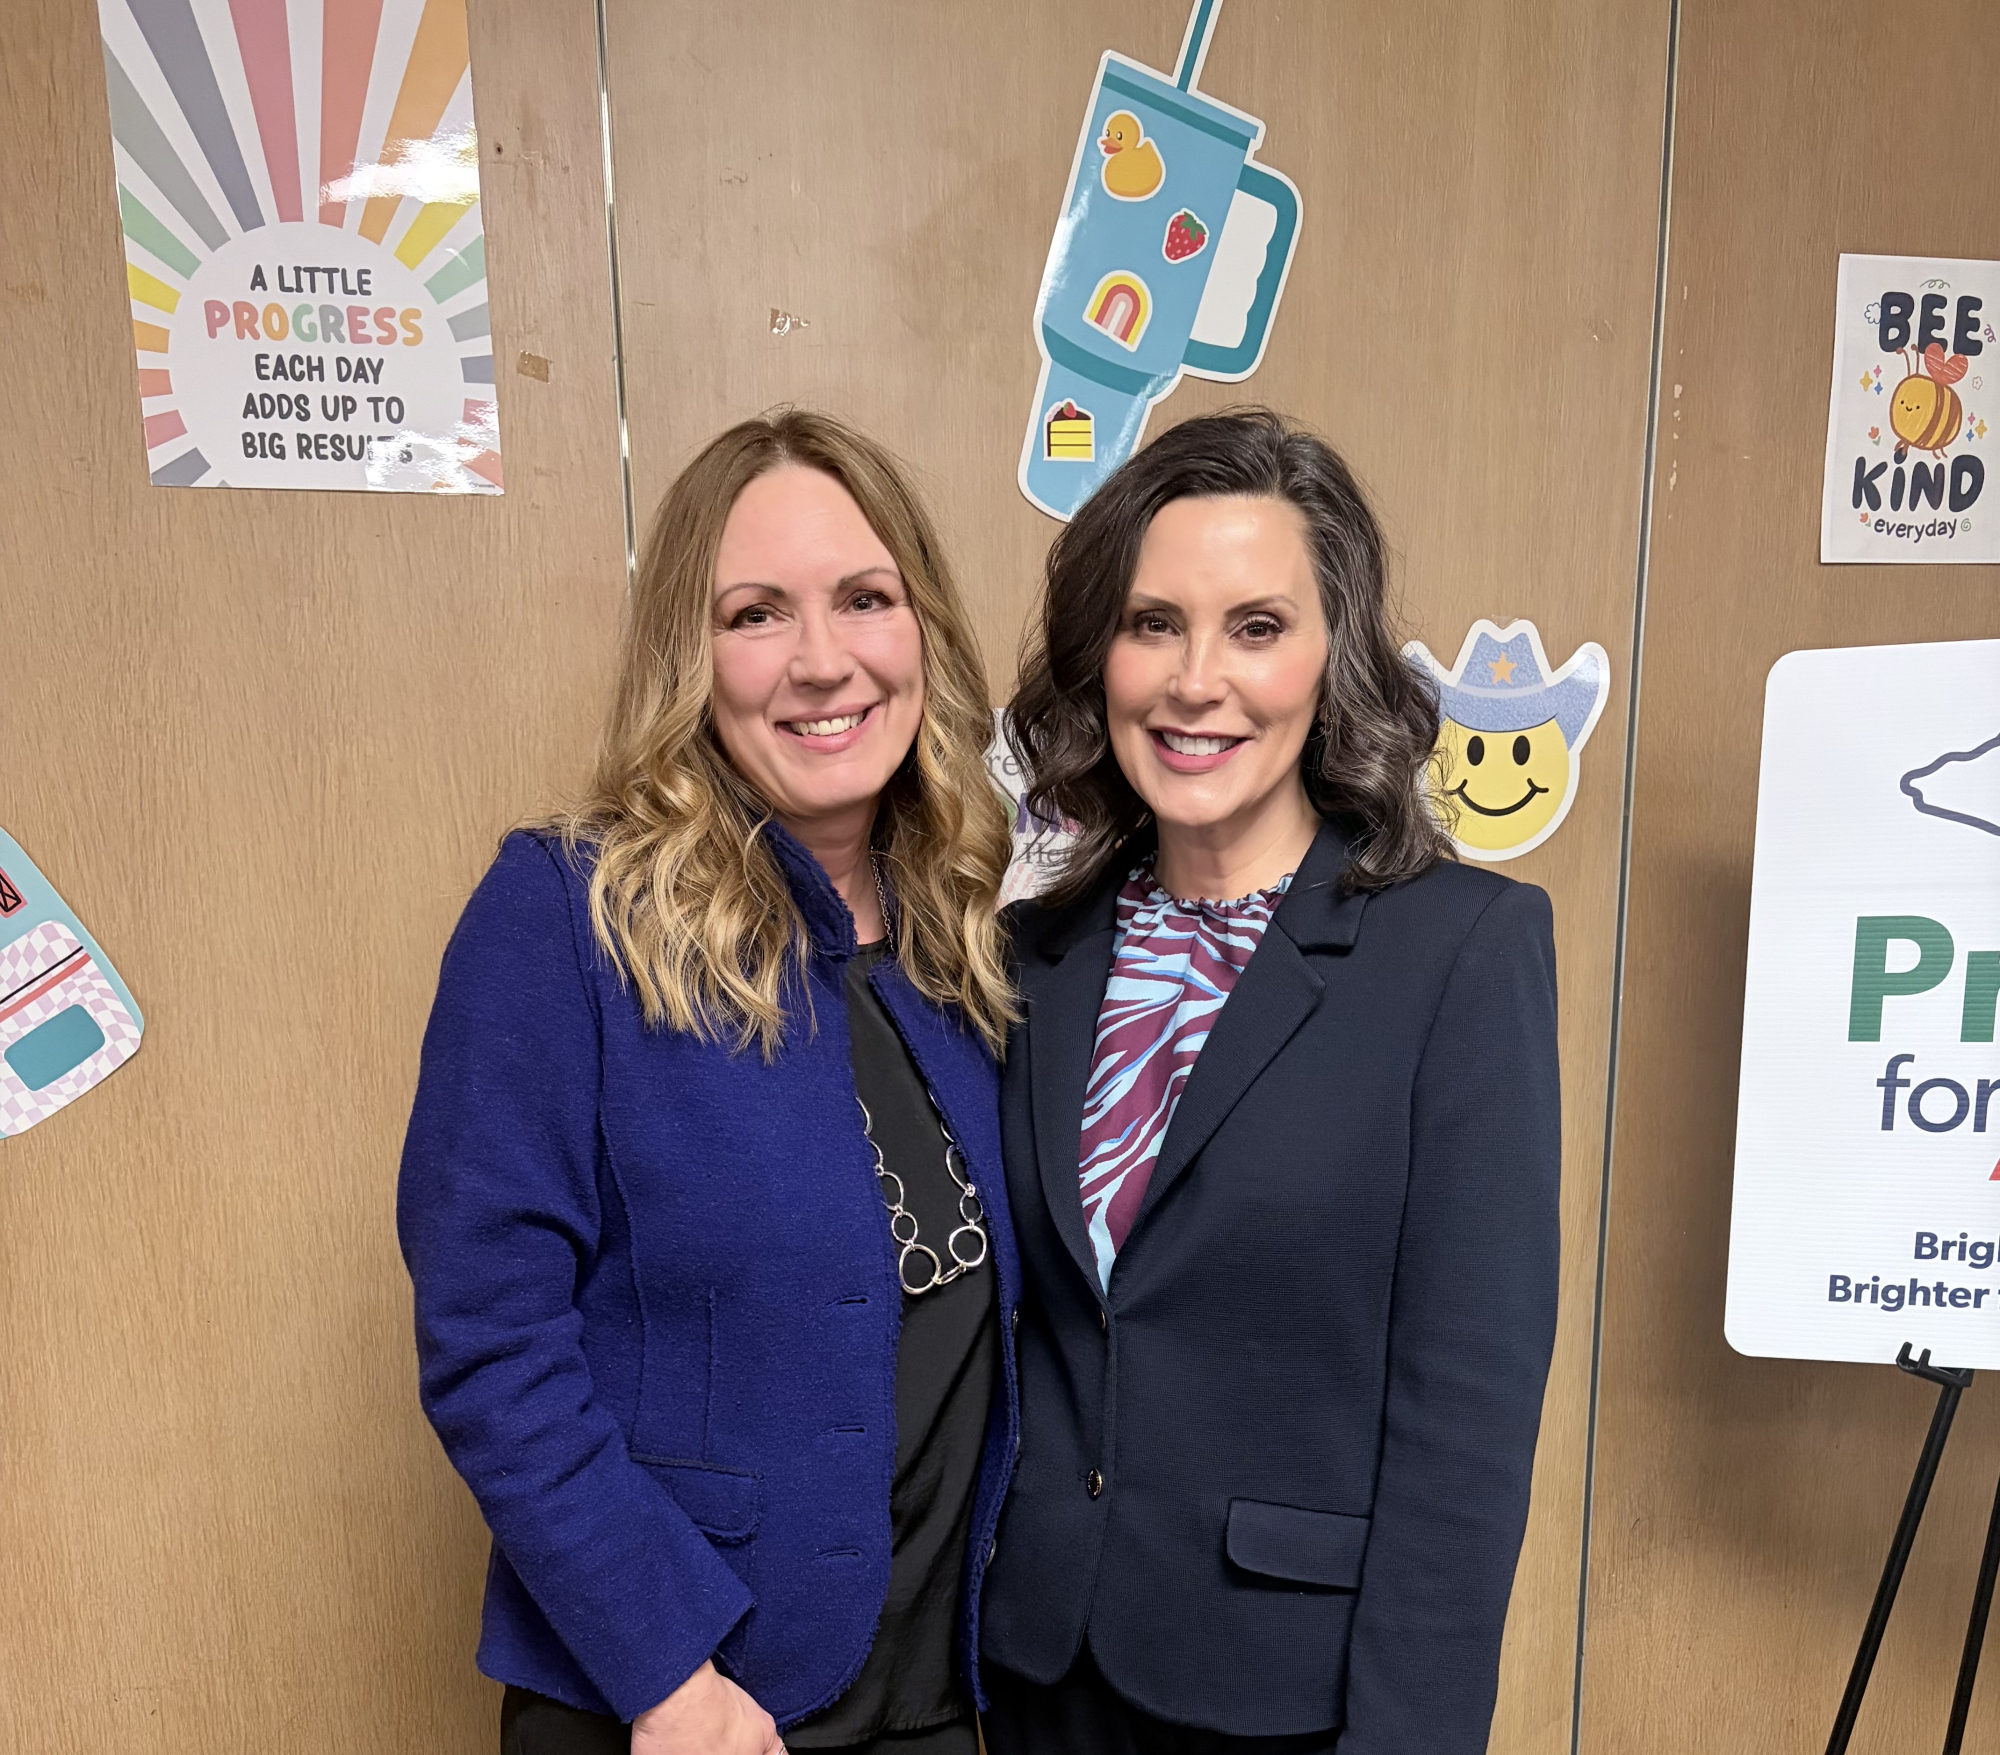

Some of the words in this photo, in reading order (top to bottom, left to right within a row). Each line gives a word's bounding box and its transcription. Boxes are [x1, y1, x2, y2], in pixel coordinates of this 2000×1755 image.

[250, 264, 268, 291] A
[277, 265, 372, 296] LITTLE
[204, 300, 424, 346] PROGRESS
[1879, 291, 1983, 356] BEE
[255, 353, 325, 382] EACH
[336, 356, 384, 385] DAY
[242, 393, 311, 422] ADDS
[321, 395, 357, 422] UP
[366, 396, 405, 424] TO
[242, 431, 286, 460] BIG
[1874, 518, 1957, 543] everyday
[1876, 1053, 2000, 1133] for
[1914, 1231, 2000, 1269] Brig
[1828, 1274, 1990, 1312] Brighter
